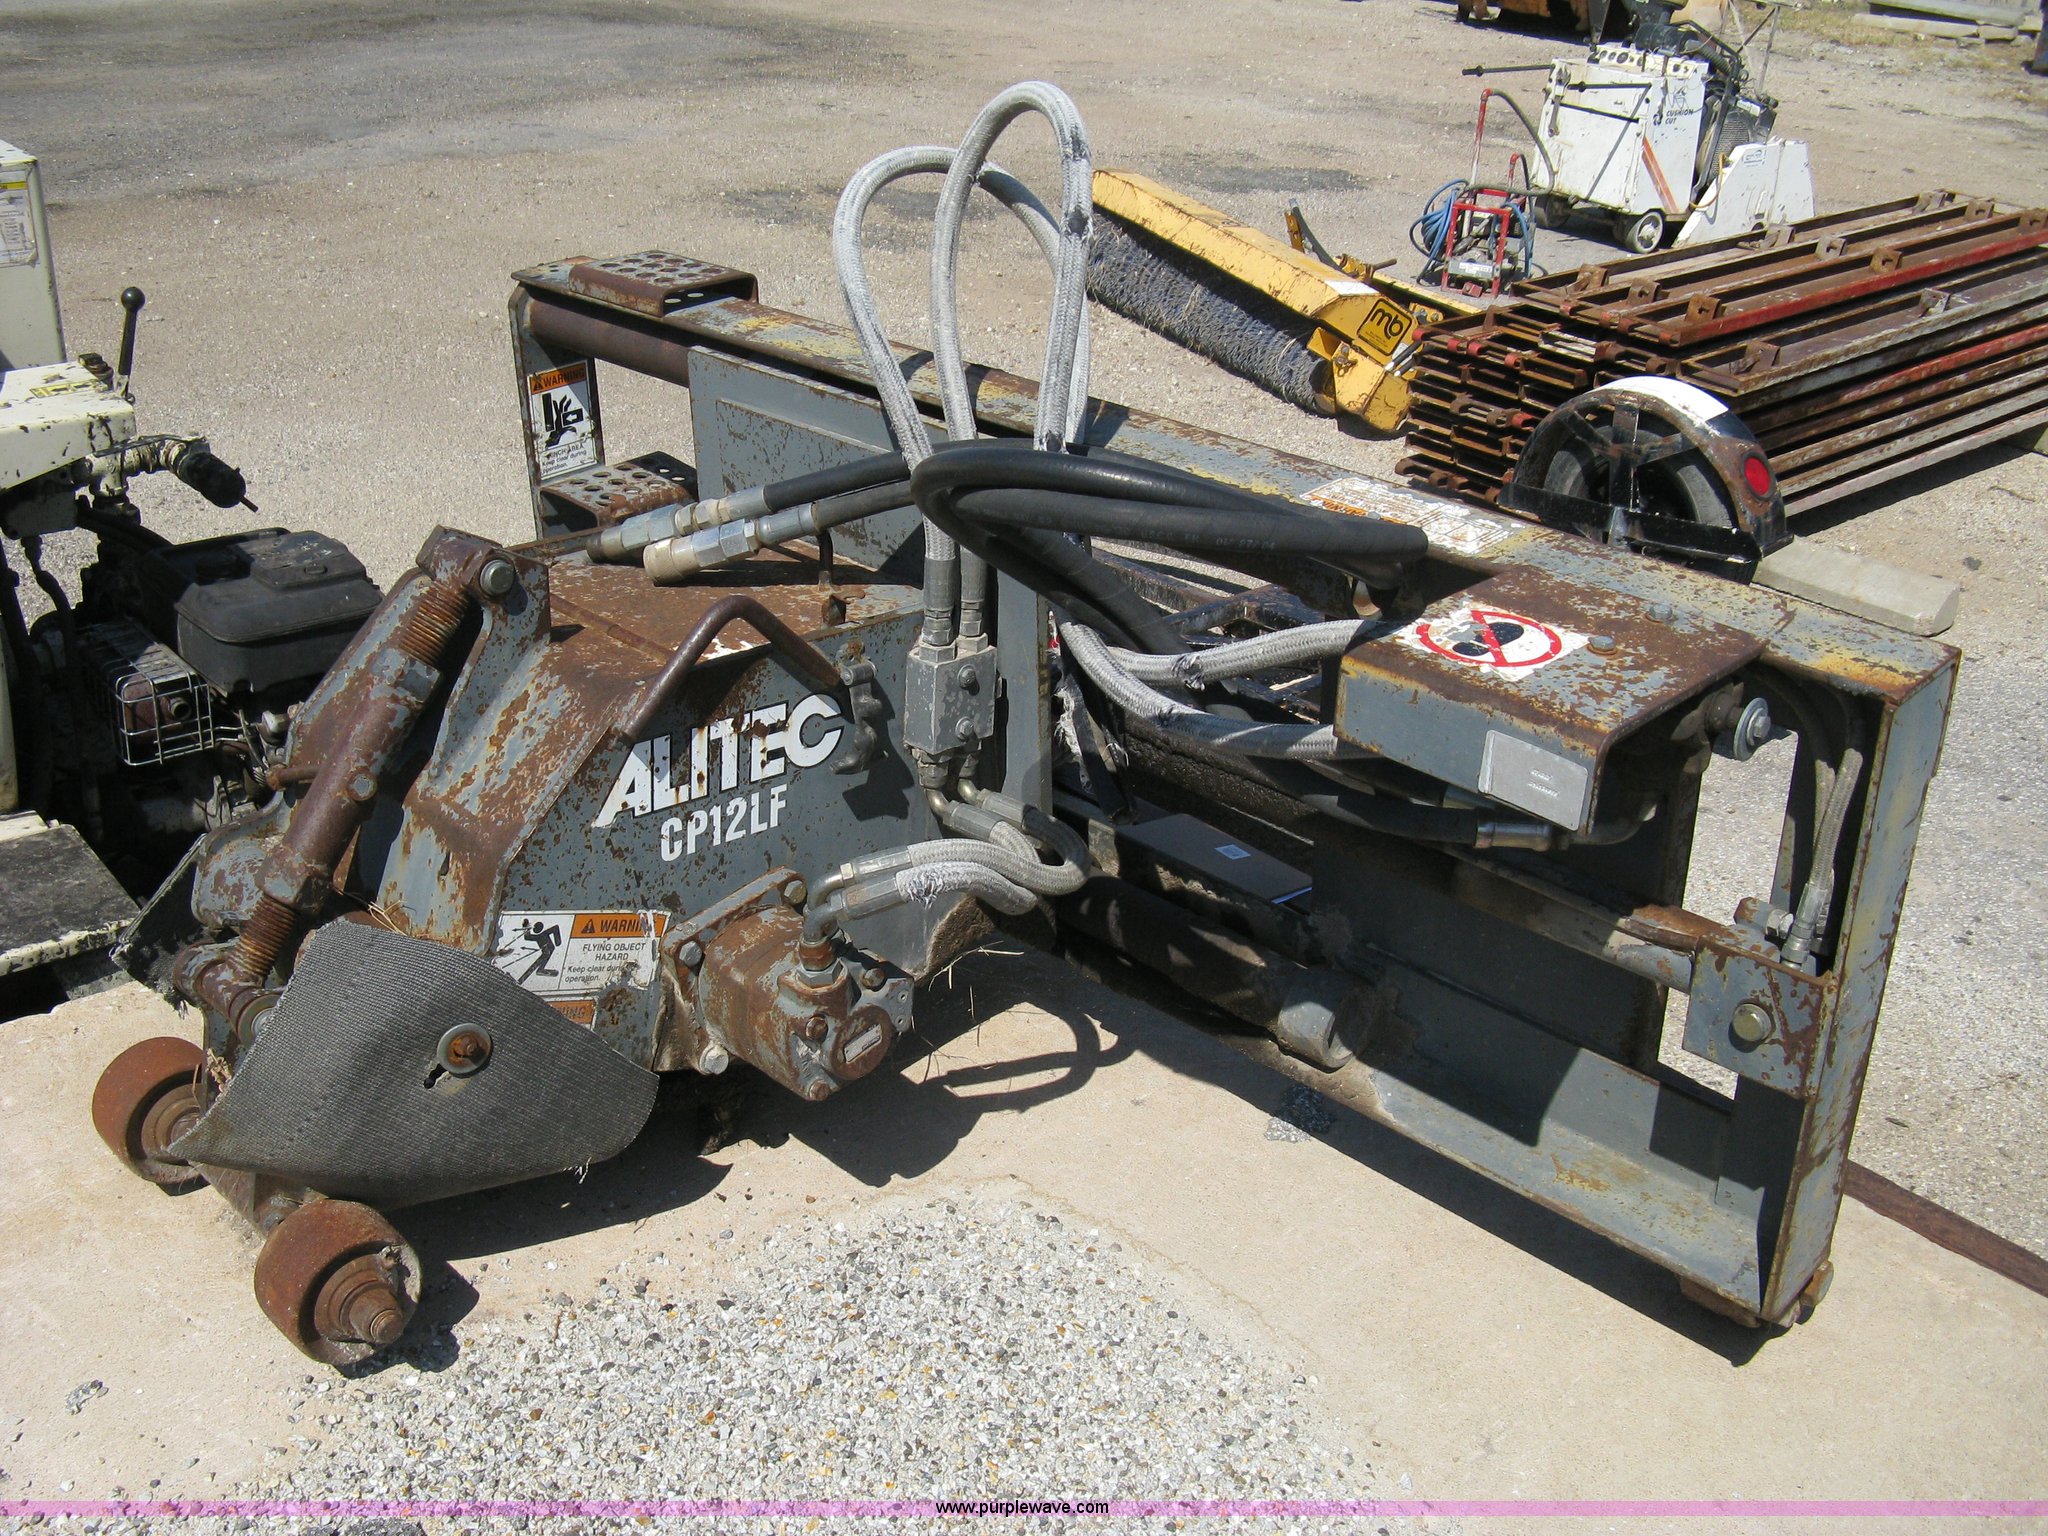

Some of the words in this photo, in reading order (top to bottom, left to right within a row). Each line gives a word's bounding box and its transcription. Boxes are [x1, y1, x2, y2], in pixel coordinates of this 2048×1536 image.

[1666, 109, 1694, 117] CUSHION
[543, 367, 585, 387] WARNING
[591, 693, 844, 828] ALITEC
[661, 784, 787, 862] CP12LF
[583, 943, 611, 951] FLYING
[613, 942, 646, 951] OBJECT
[595, 952, 629, 961] HAZARD
[567, 965, 585, 974] Keep
[587, 964, 605, 973] clear
